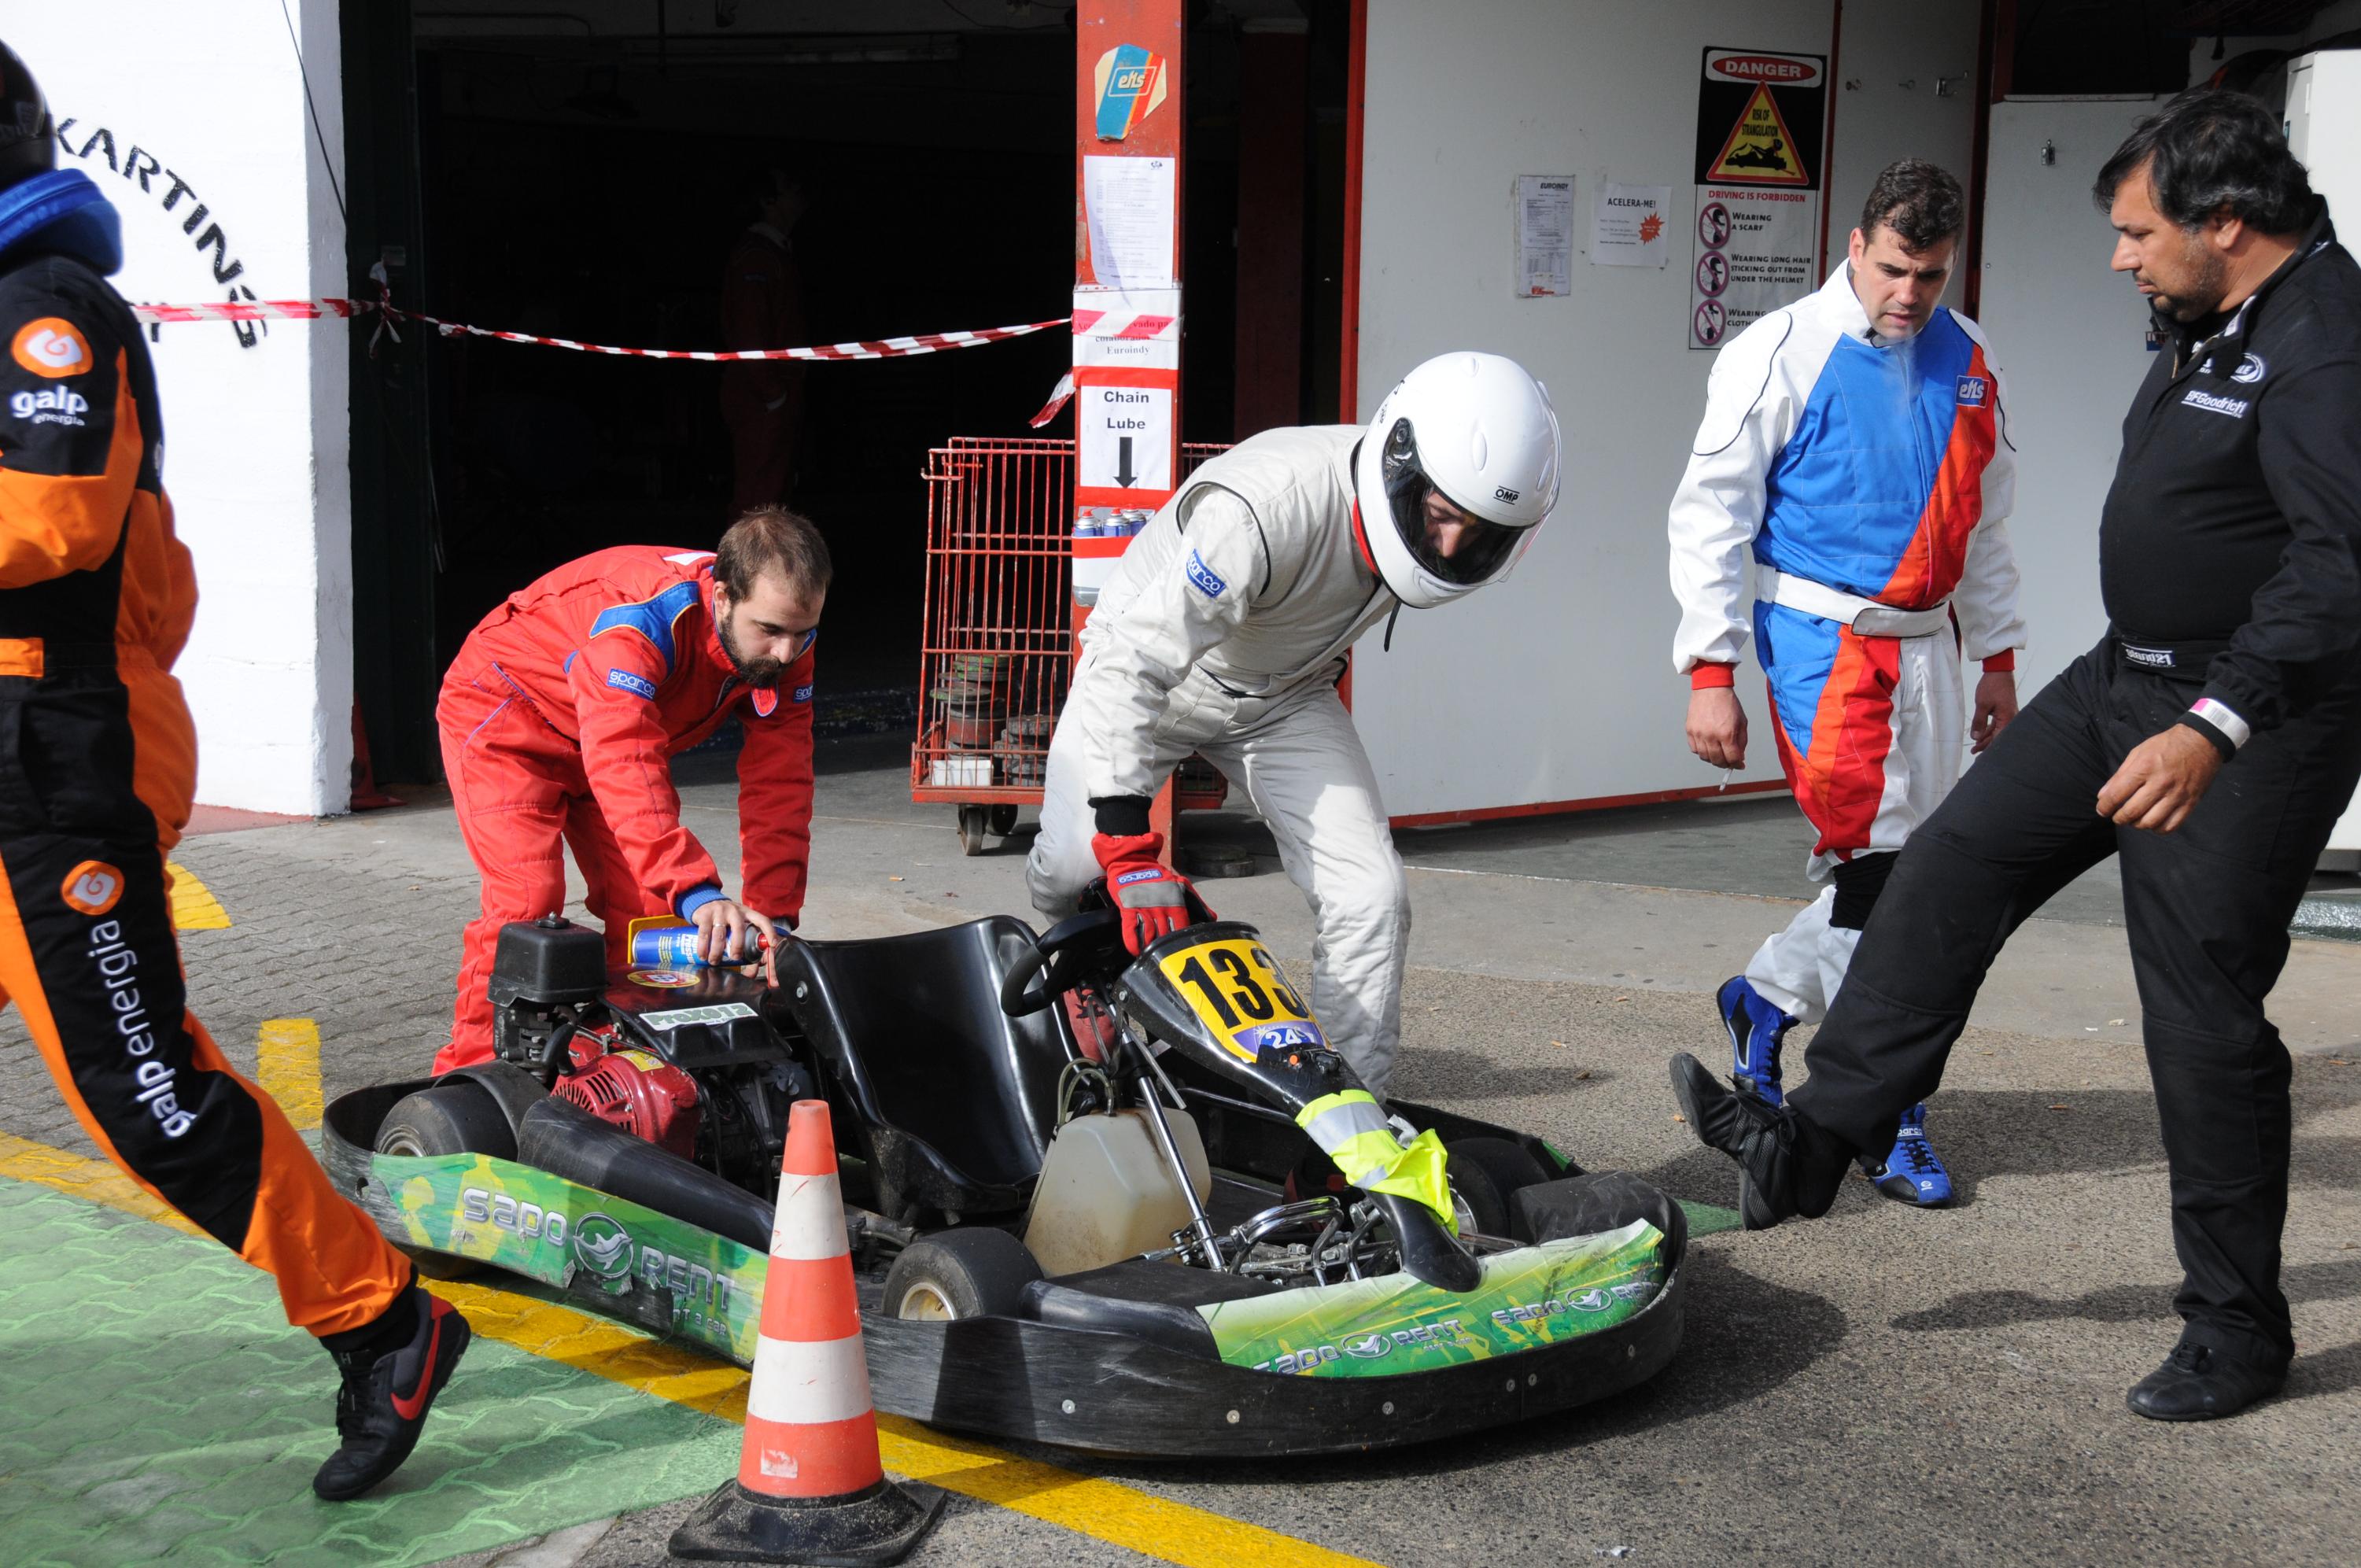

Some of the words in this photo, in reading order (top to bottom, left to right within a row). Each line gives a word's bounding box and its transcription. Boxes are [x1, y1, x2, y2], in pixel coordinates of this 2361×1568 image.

[1725, 61, 1801, 77] DANGER
[1607, 197, 1656, 208] ACELERA-ME!
[1708, 190, 1745, 200] DRIVING
[1756, 193, 1806, 202] FORBIDDEN
[1732, 212, 1772, 221] WEARING
[1731, 253, 1769, 263] WEARING
[1107, 346, 1149, 355] Euroindy
[12, 384, 89, 419] galp
[1104, 391, 1149, 403] Chain
[33, 413, 85, 426] energia
[1107, 418, 1145, 429] Lube
[1496, 489, 1518, 502] OMP
[610, 671, 655, 695] sparco
[1119, 870, 1159, 883] sparco
[88, 920, 155, 1057] energia
[135, 1061, 197, 1138] galp
